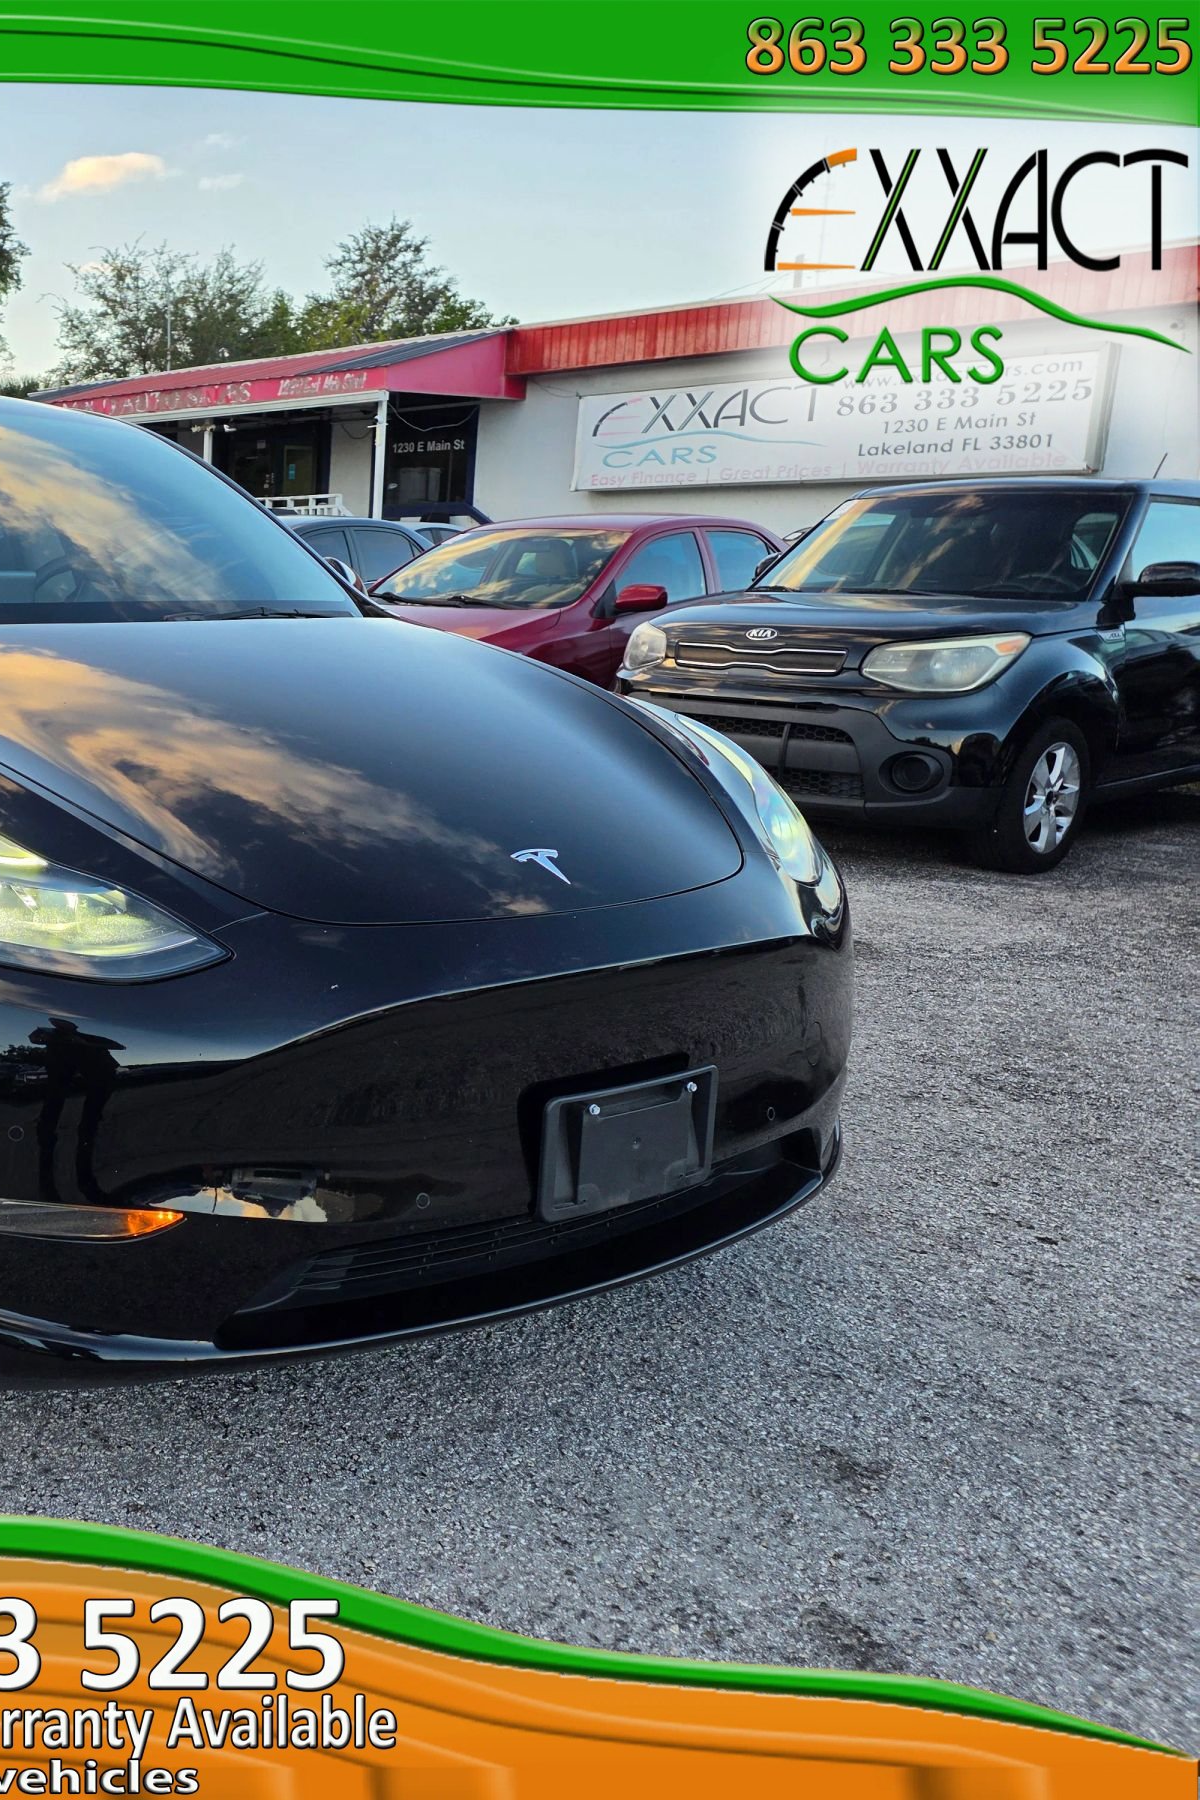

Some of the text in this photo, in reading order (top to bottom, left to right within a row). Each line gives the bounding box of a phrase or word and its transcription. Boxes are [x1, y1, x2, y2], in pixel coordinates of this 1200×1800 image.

[836, 377, 1093, 417] 863 333 5225
[592, 384, 835, 438] EXXACT
[883, 411, 1037, 434] 1230 E Main St
[392, 438, 465, 454] 1230 E Main St
[601, 444, 718, 469] CARS
[857, 433, 1054, 458] Lakeland FL 33801
[590, 451, 1068, 488] Easy Finance Great Prices Warranty Available
